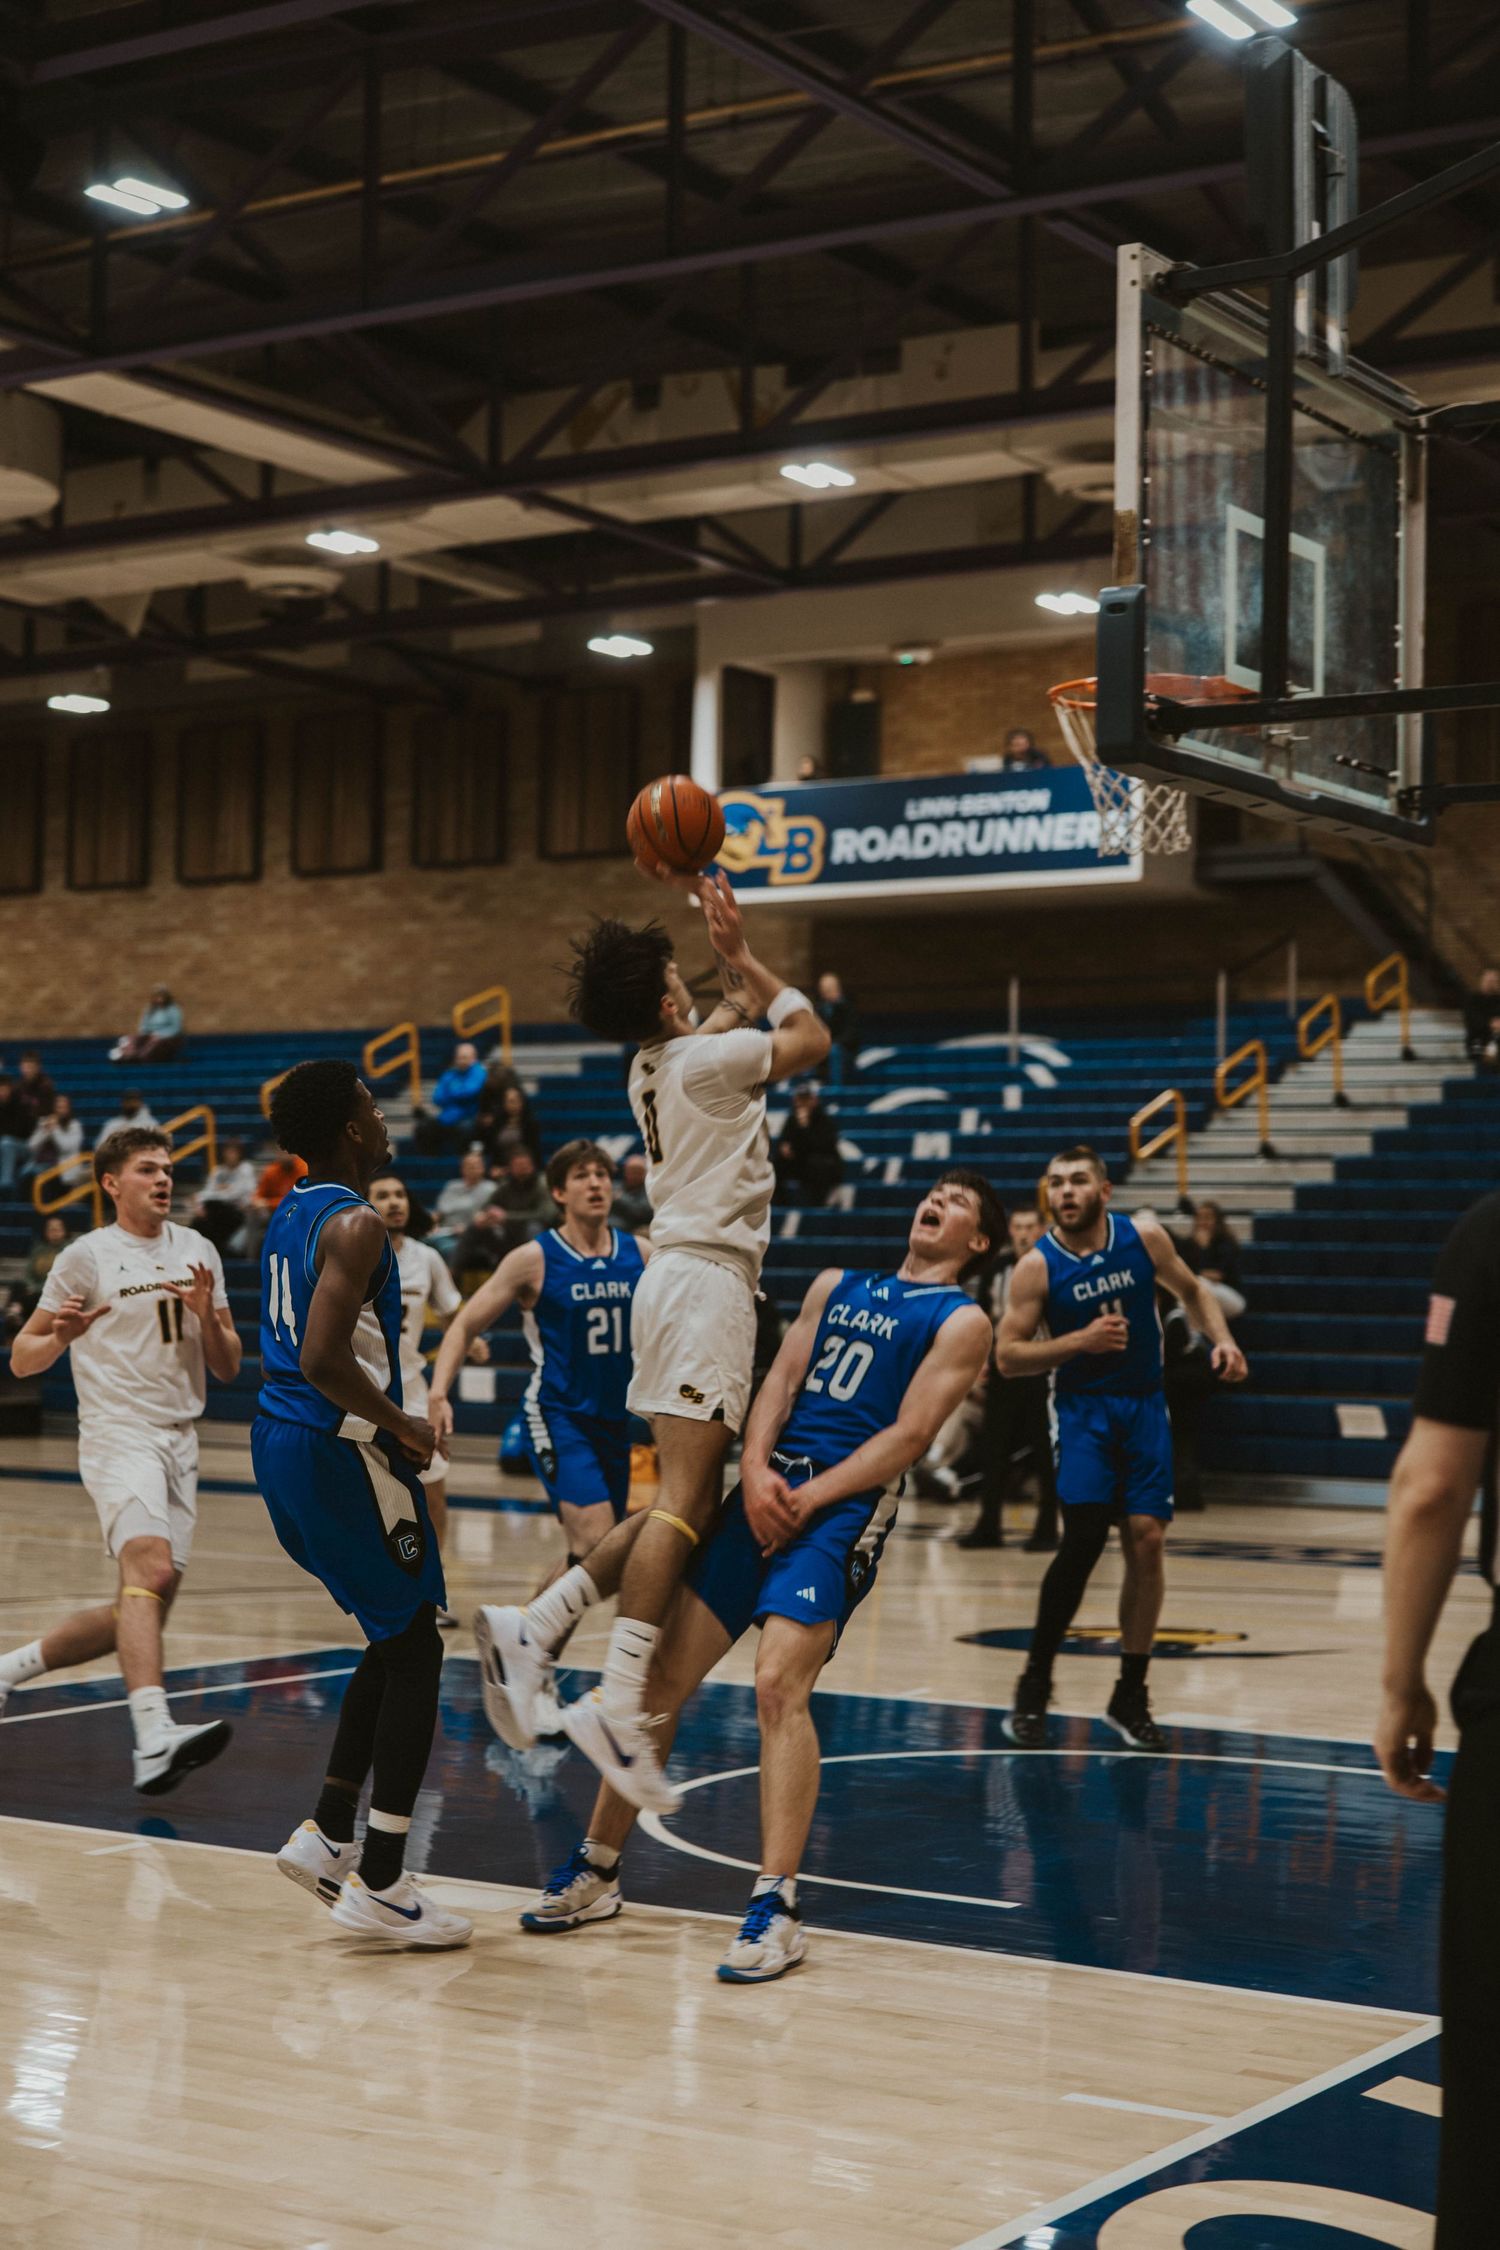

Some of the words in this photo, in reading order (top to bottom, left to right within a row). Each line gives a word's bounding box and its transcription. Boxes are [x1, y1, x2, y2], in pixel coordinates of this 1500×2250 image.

[904, 788, 1052, 821] LINN-BENTON
[570, 1281, 632, 1301] CLARK
[1072, 1269, 1136, 1302] CLARK
[157, 1298, 183, 1343] 11
[586, 1305, 622, 1356] 21
[827, 1303, 900, 1342] CLARK
[805, 1334, 875, 1403] 20
